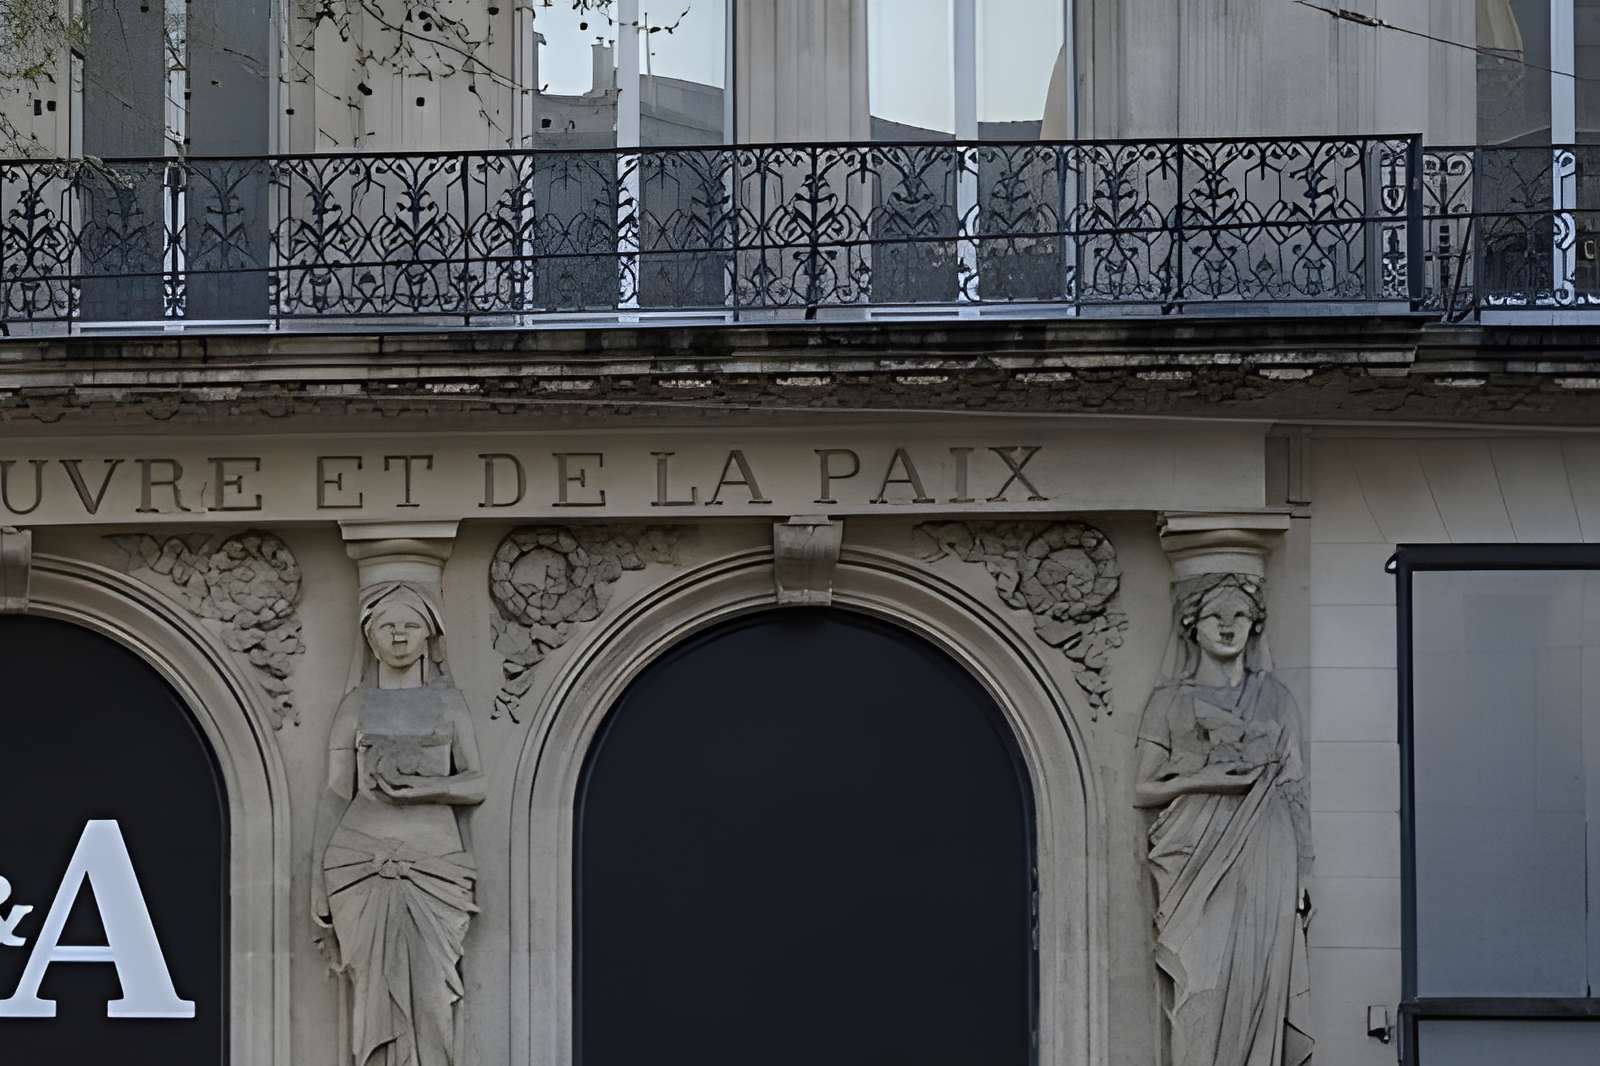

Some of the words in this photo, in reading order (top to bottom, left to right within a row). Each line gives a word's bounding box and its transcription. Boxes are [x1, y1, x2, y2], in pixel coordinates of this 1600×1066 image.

[317, 454, 434, 510] ET
[477, 452, 606, 509] DE
[651, 448, 773, 507] LA
[813, 445, 1050, 505] PAIX
